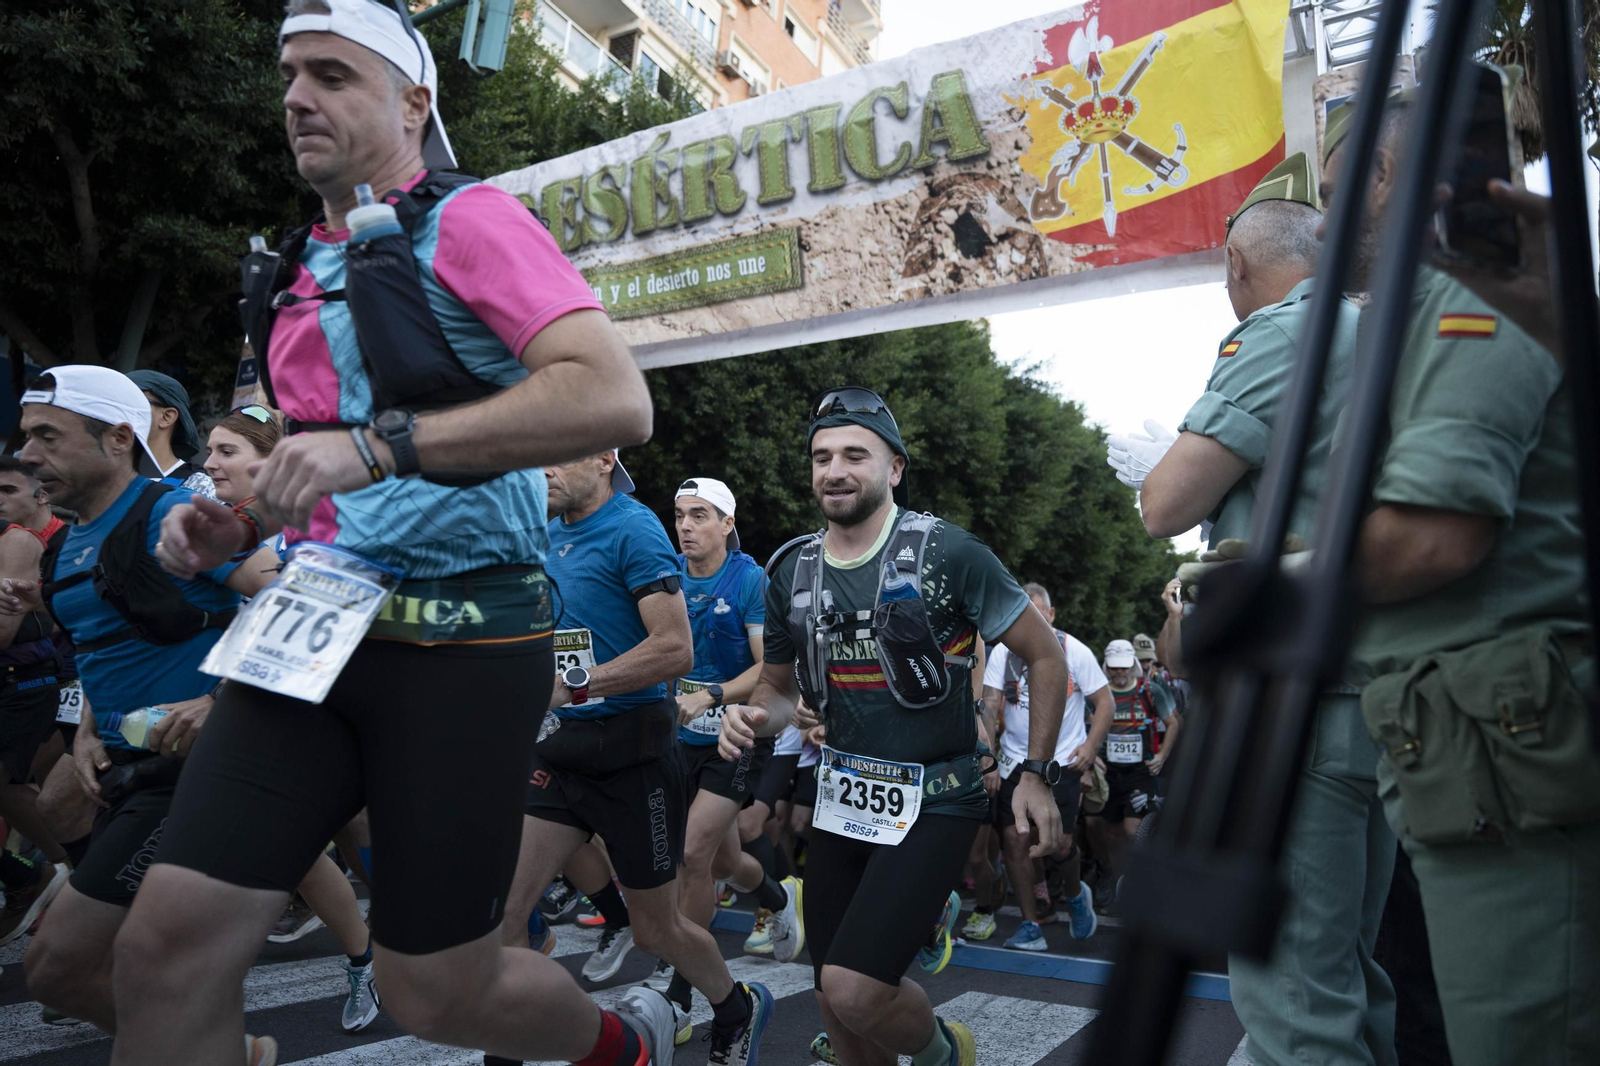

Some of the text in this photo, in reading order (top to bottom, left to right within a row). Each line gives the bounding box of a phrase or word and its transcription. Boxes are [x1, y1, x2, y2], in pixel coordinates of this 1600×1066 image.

[518, 69, 992, 250] ESÉRTICA
[610, 284, 620, 304] y
[628, 276, 640, 298] el
[647, 269, 699, 294] desierto
[706, 262, 731, 283] nos
[738, 255, 766, 276] une
[238, 660, 270, 680] sisa
[906, 658, 930, 689] AONIJIE
[1114, 743, 1137, 753] 2912
[839, 777, 904, 817] 2359
[872, 818, 896, 827] CASTILLA
[738, 1028, 752, 1061] HOKA
